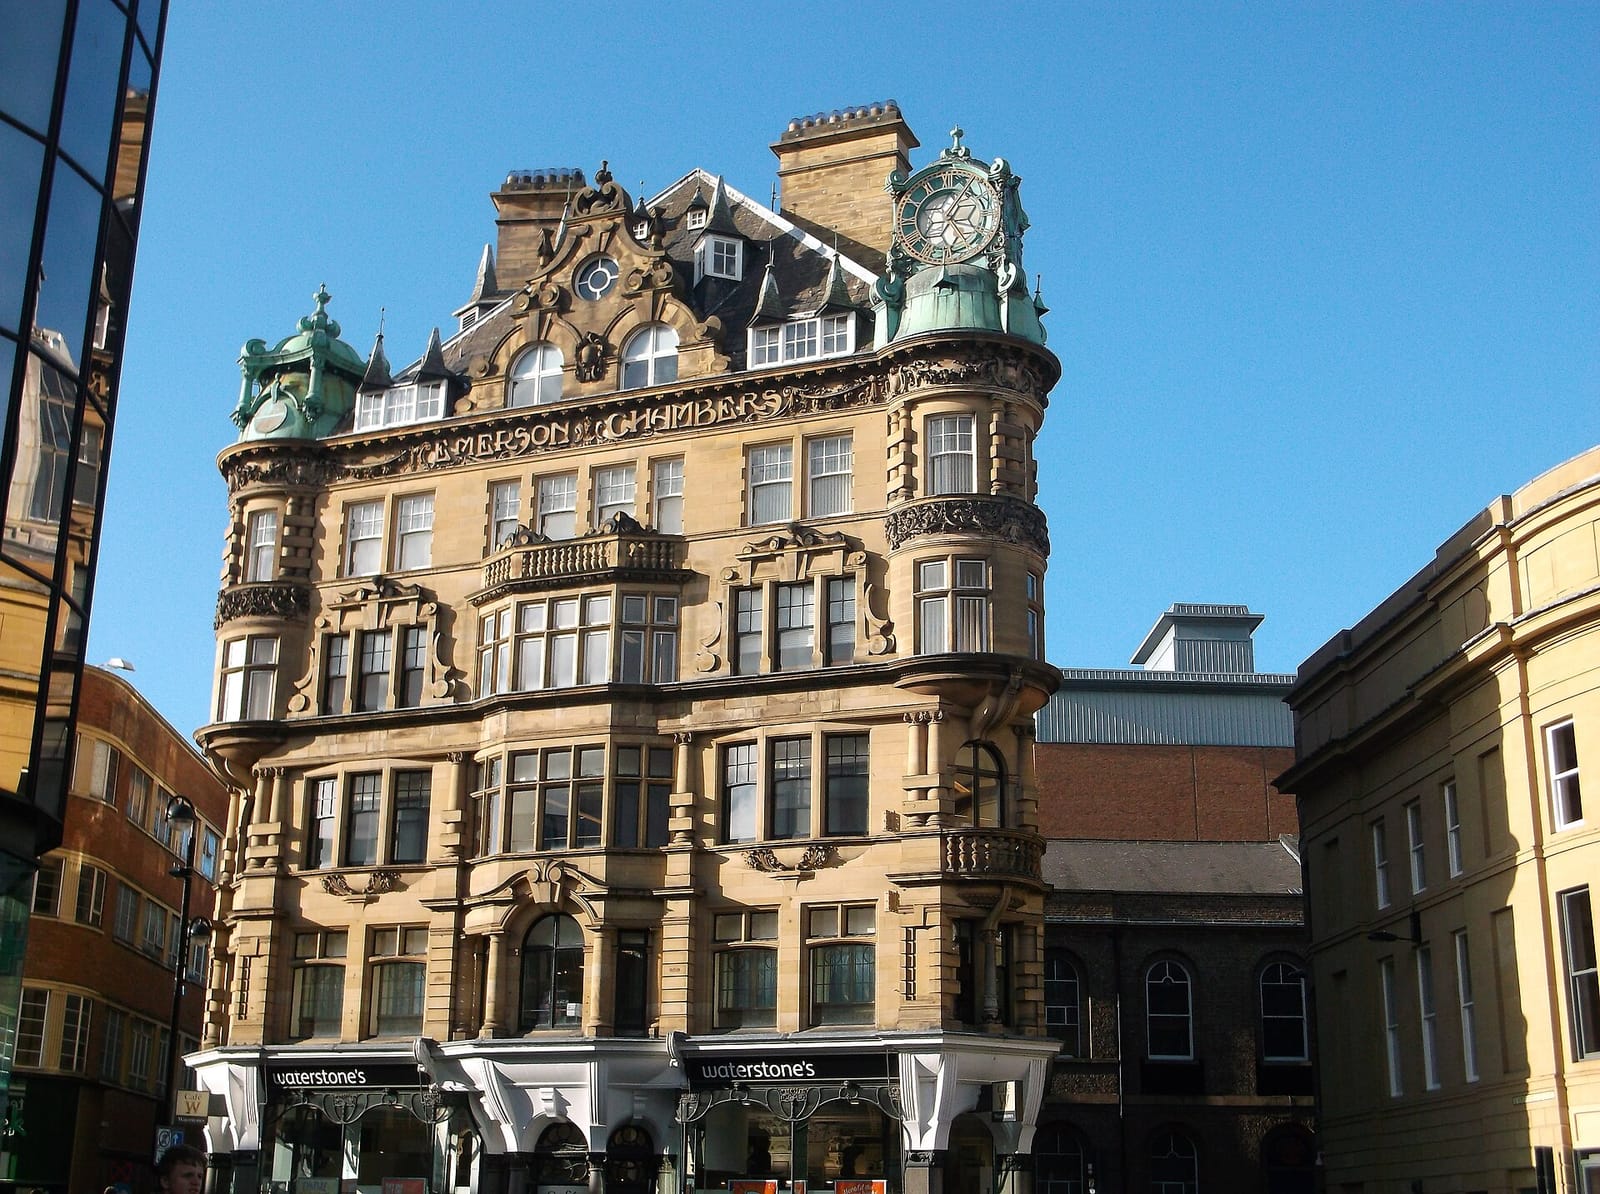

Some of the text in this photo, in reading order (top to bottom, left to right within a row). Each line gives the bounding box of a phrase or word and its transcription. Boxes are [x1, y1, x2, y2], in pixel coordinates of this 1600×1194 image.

[434, 388, 783, 463] EMERSON CHAMBERS
[272, 1064, 367, 1085] waterstone's
[701, 1060, 816, 1079] waterstone's
